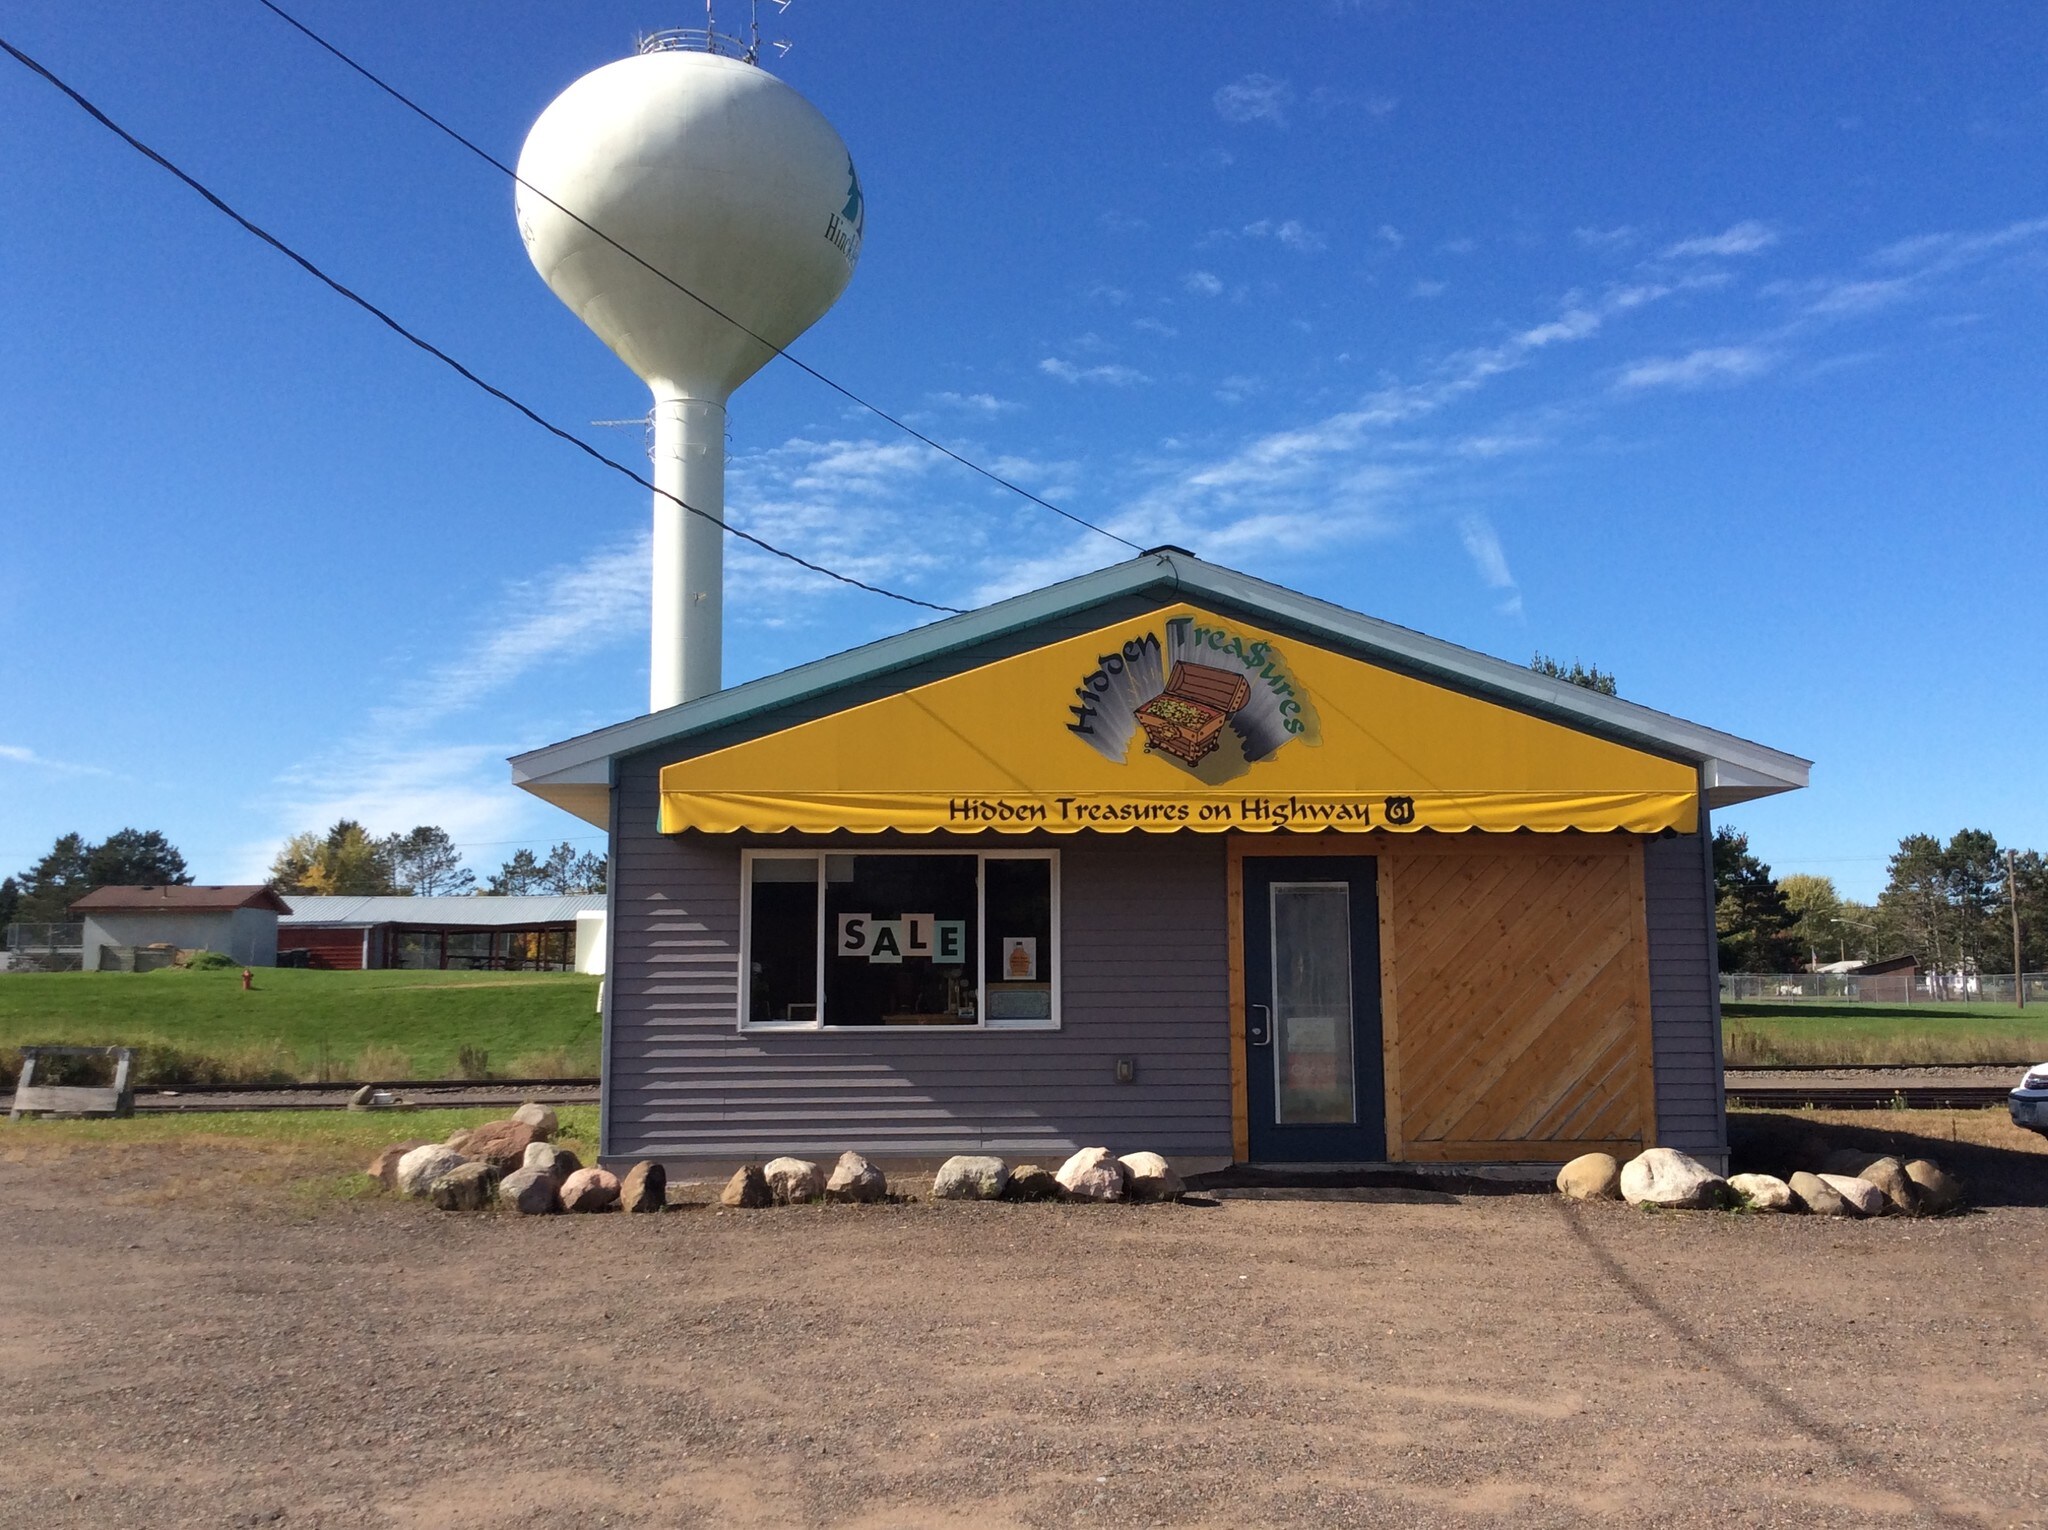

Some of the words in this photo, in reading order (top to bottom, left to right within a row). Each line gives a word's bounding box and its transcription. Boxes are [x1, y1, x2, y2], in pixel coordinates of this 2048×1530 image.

[949, 797, 1048, 822] Hidden
[1054, 797, 1190, 821] Treasures
[1198, 804, 1232, 821] on
[1241, 796, 1370, 827] Highway
[1390, 802, 1409, 819] 61
[844, 919, 959, 957] SALE
